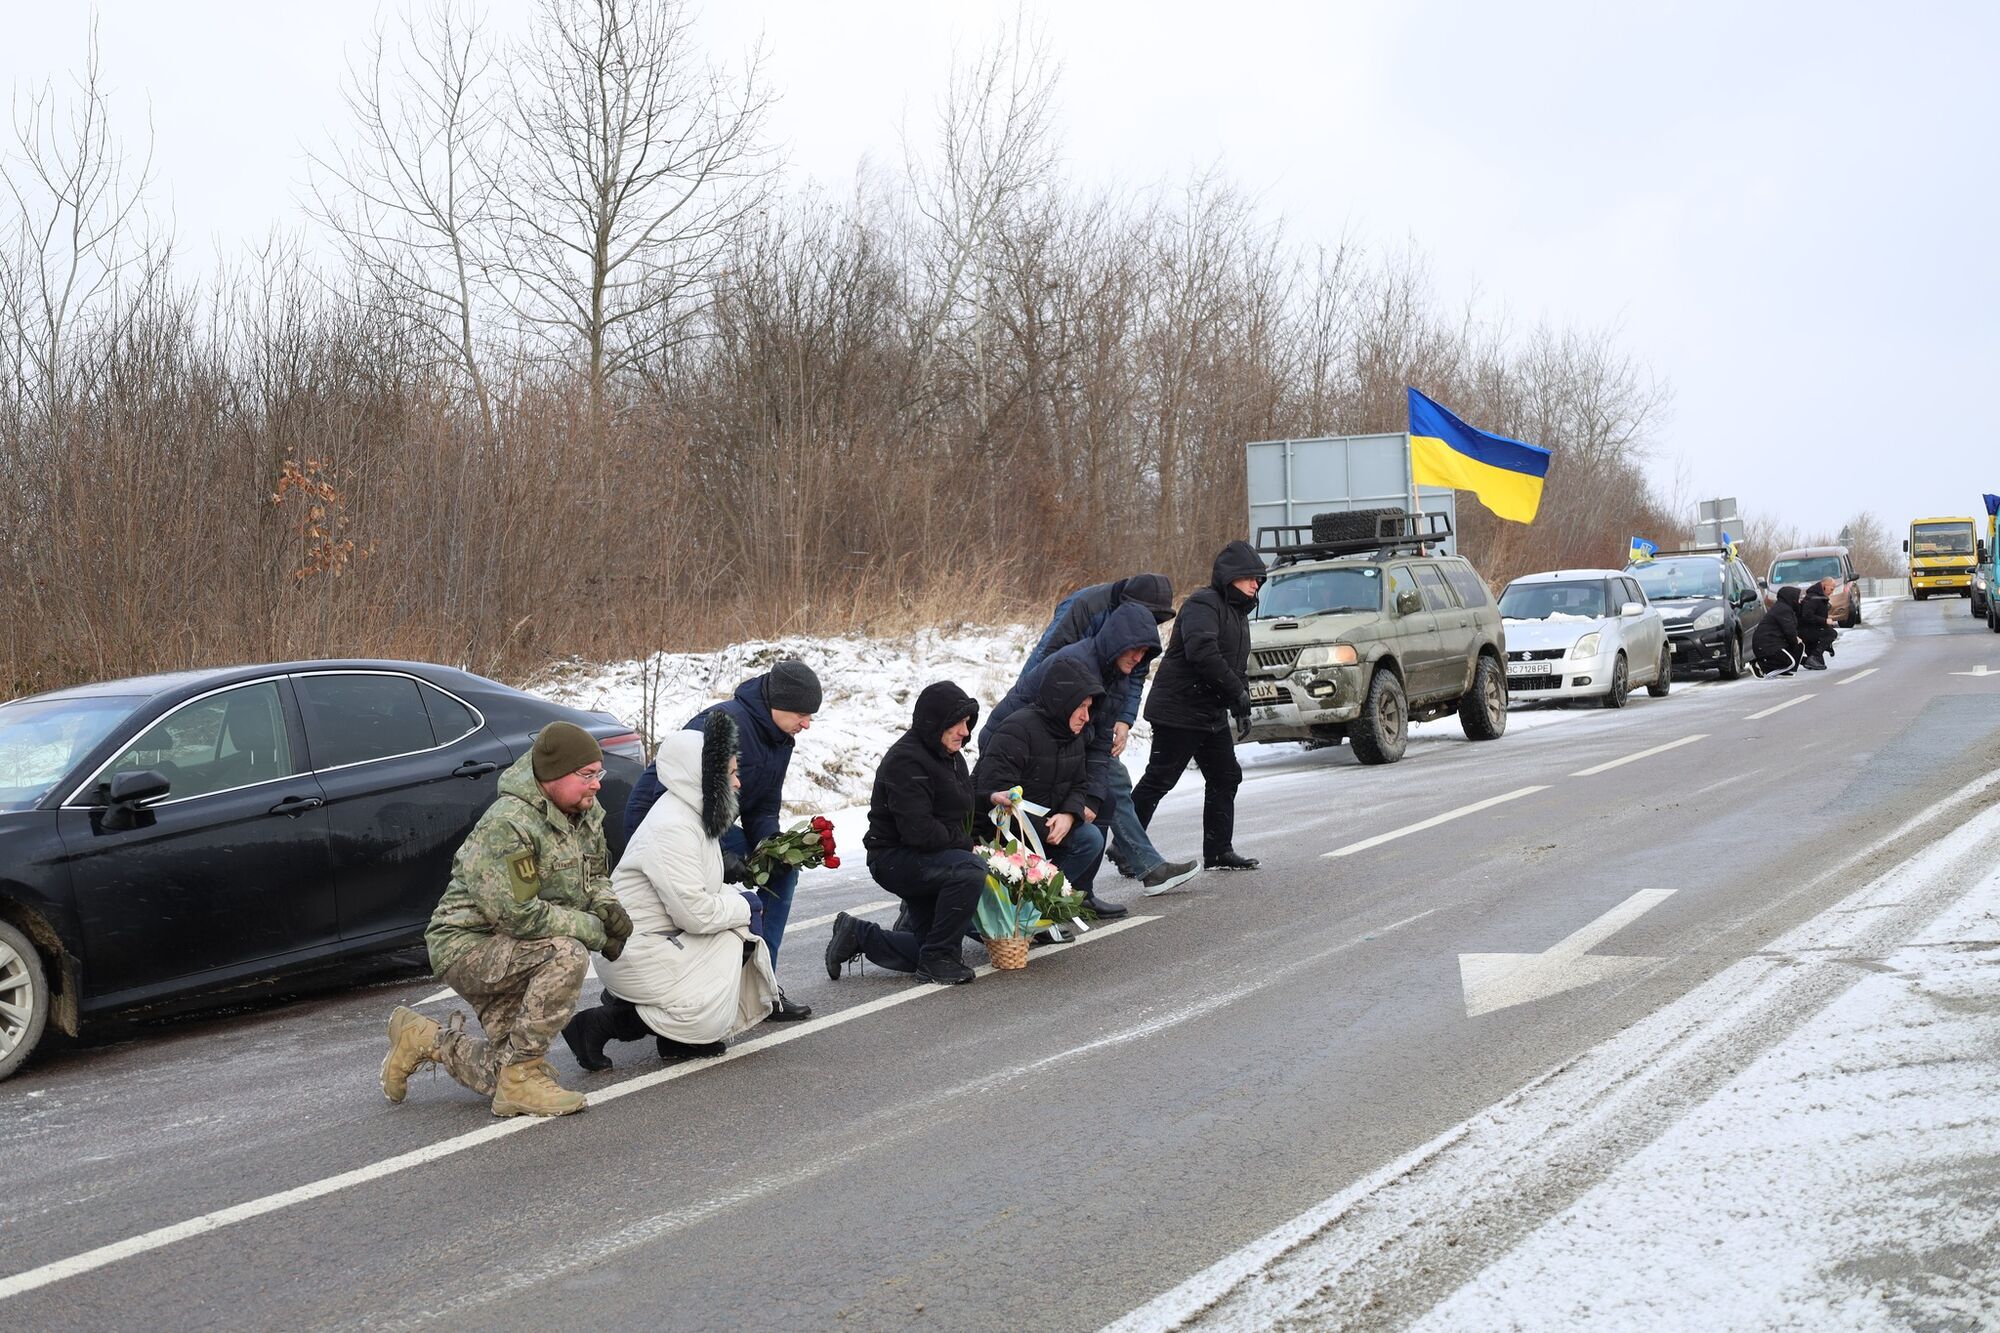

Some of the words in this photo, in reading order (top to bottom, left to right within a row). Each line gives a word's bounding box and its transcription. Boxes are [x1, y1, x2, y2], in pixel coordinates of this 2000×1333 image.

[1519, 665, 1537, 673] 7128
[1537, 664, 1549, 673] PE
[1249, 685, 1273, 698] CUX
